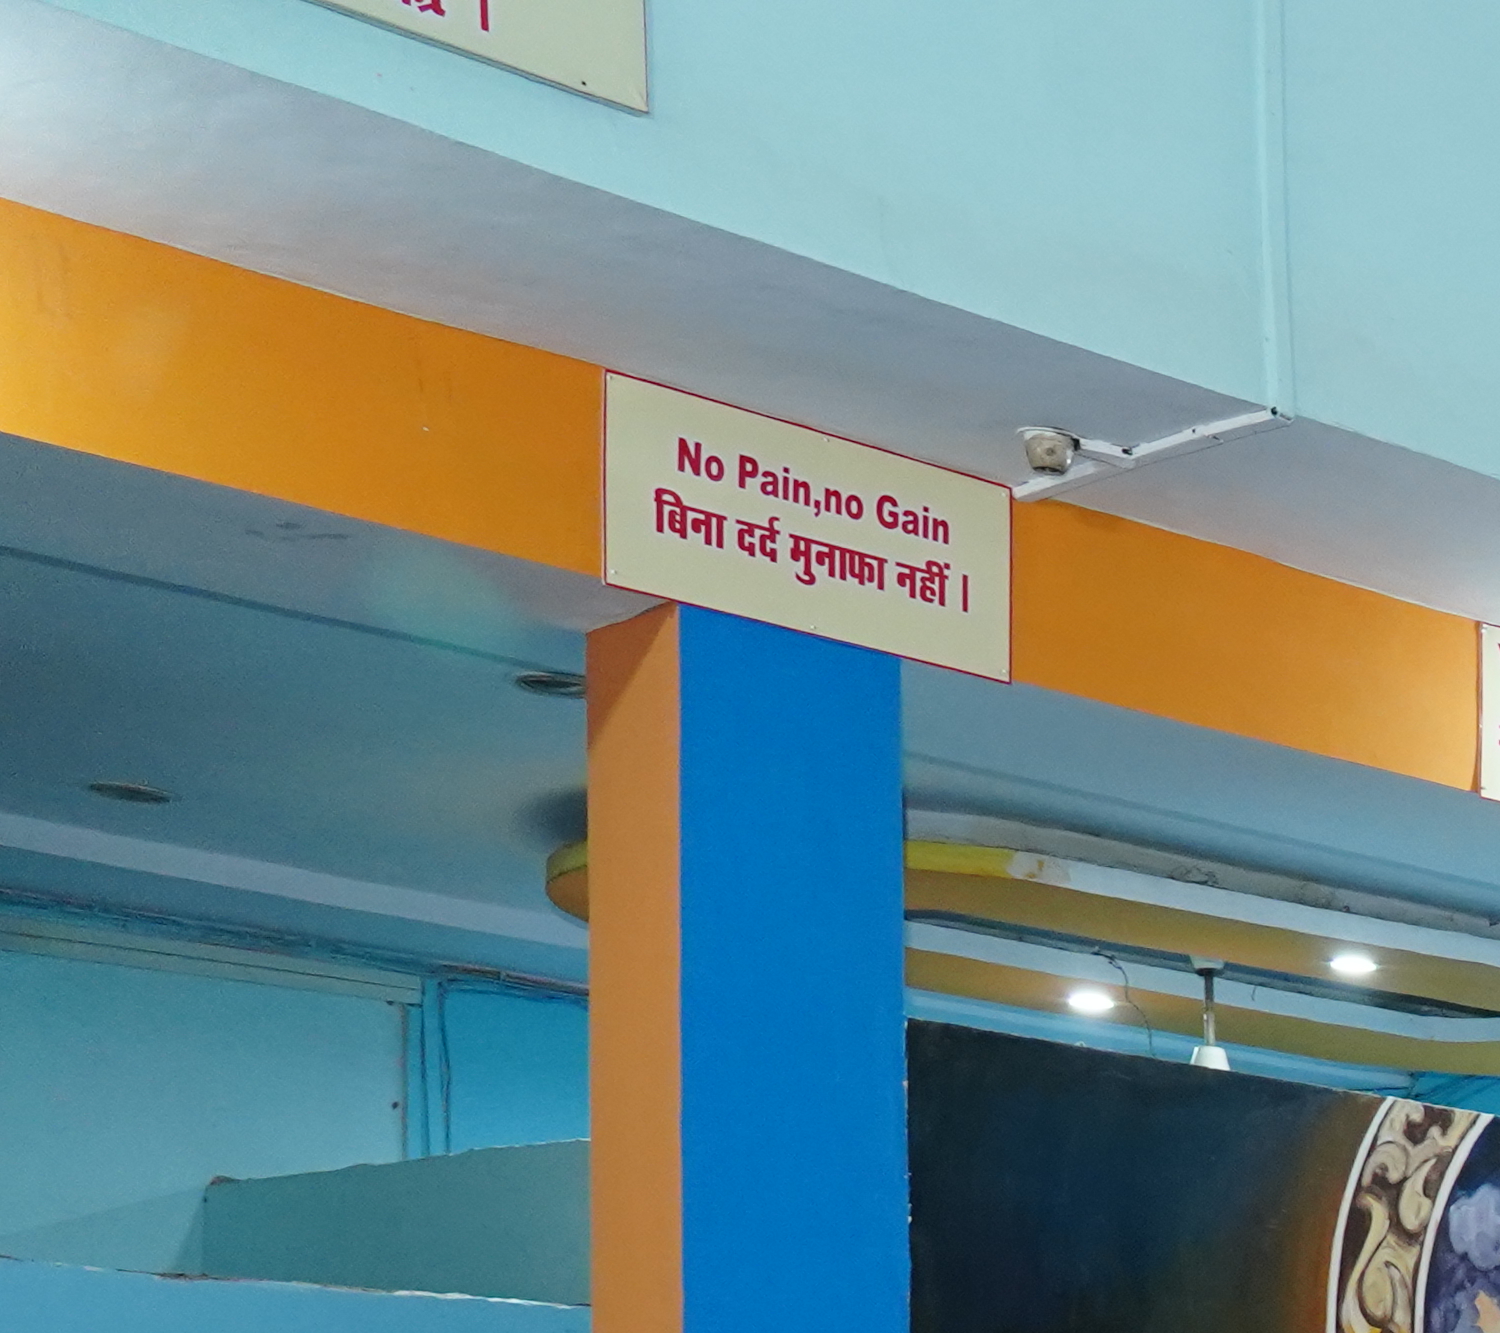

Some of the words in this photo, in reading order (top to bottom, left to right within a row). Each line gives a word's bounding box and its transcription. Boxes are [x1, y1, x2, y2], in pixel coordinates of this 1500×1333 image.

[653, 488, 727, 549] बिना
[735, 515, 781, 562] दर्द
[788, 532, 889, 591] मुनाफा
[895, 559, 951, 607] नहीं
[677, 436, 724, 481] No
[876, 494, 950, 545] Gain
